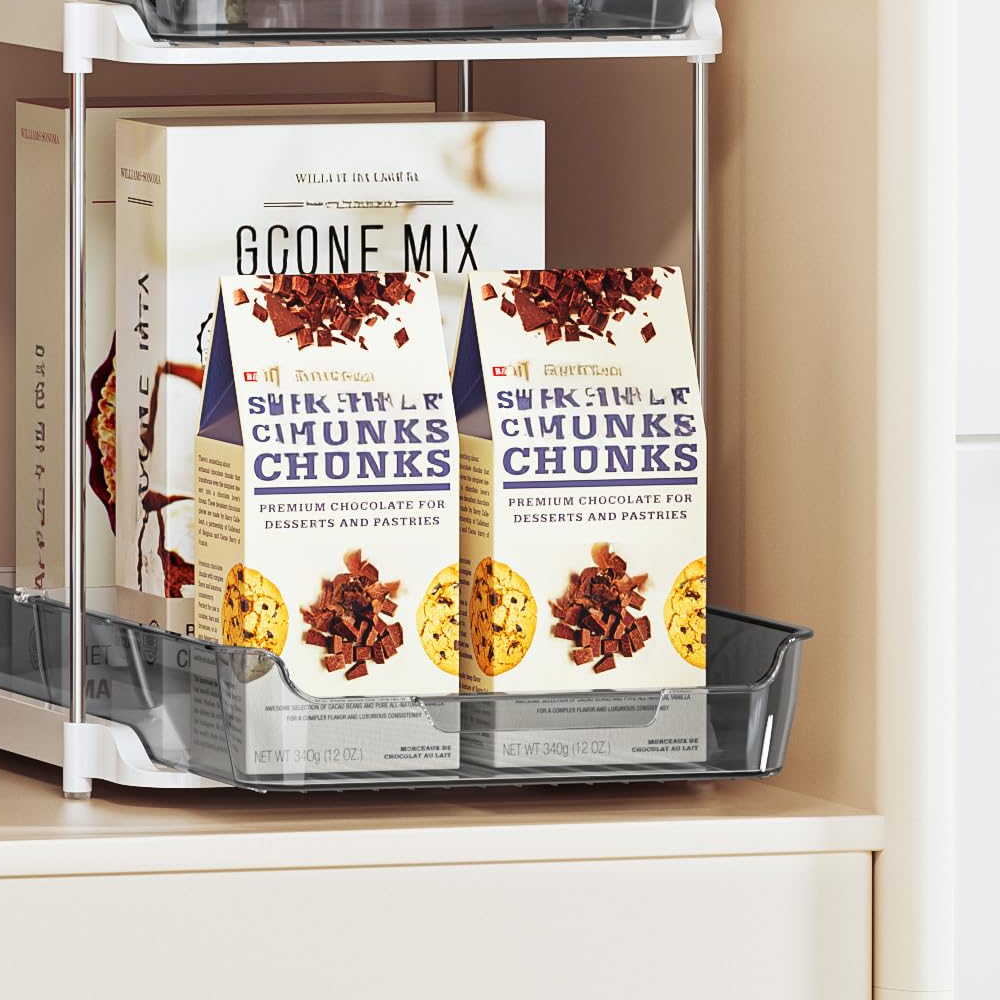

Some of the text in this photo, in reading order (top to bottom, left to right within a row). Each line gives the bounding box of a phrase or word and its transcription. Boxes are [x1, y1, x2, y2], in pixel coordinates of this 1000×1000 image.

[404, 223, 479, 274] MIX
[253, 449, 451, 481] CHUNKS
[503, 443, 698, 475] CHUNKS
[259, 500, 446, 513] PREMIUM CHOCOLATE FOR
[508, 494, 693, 507] PREMIUM CHOCOLATE FOR
[264, 516, 441, 530] DESSERTS AND PASTRIES
[513, 510, 688, 523] DESSERTS AND PASTRIES
[254, 749, 272, 763] NET
[275, 749, 290, 762] WT
[294, 749, 320, 764] 340g
[323, 748, 340, 762] (12
[503, 743, 521, 756] NET
[524, 742, 540, 755] WT
[543, 742, 569, 757] 340g
[572, 741, 589, 756] (12
